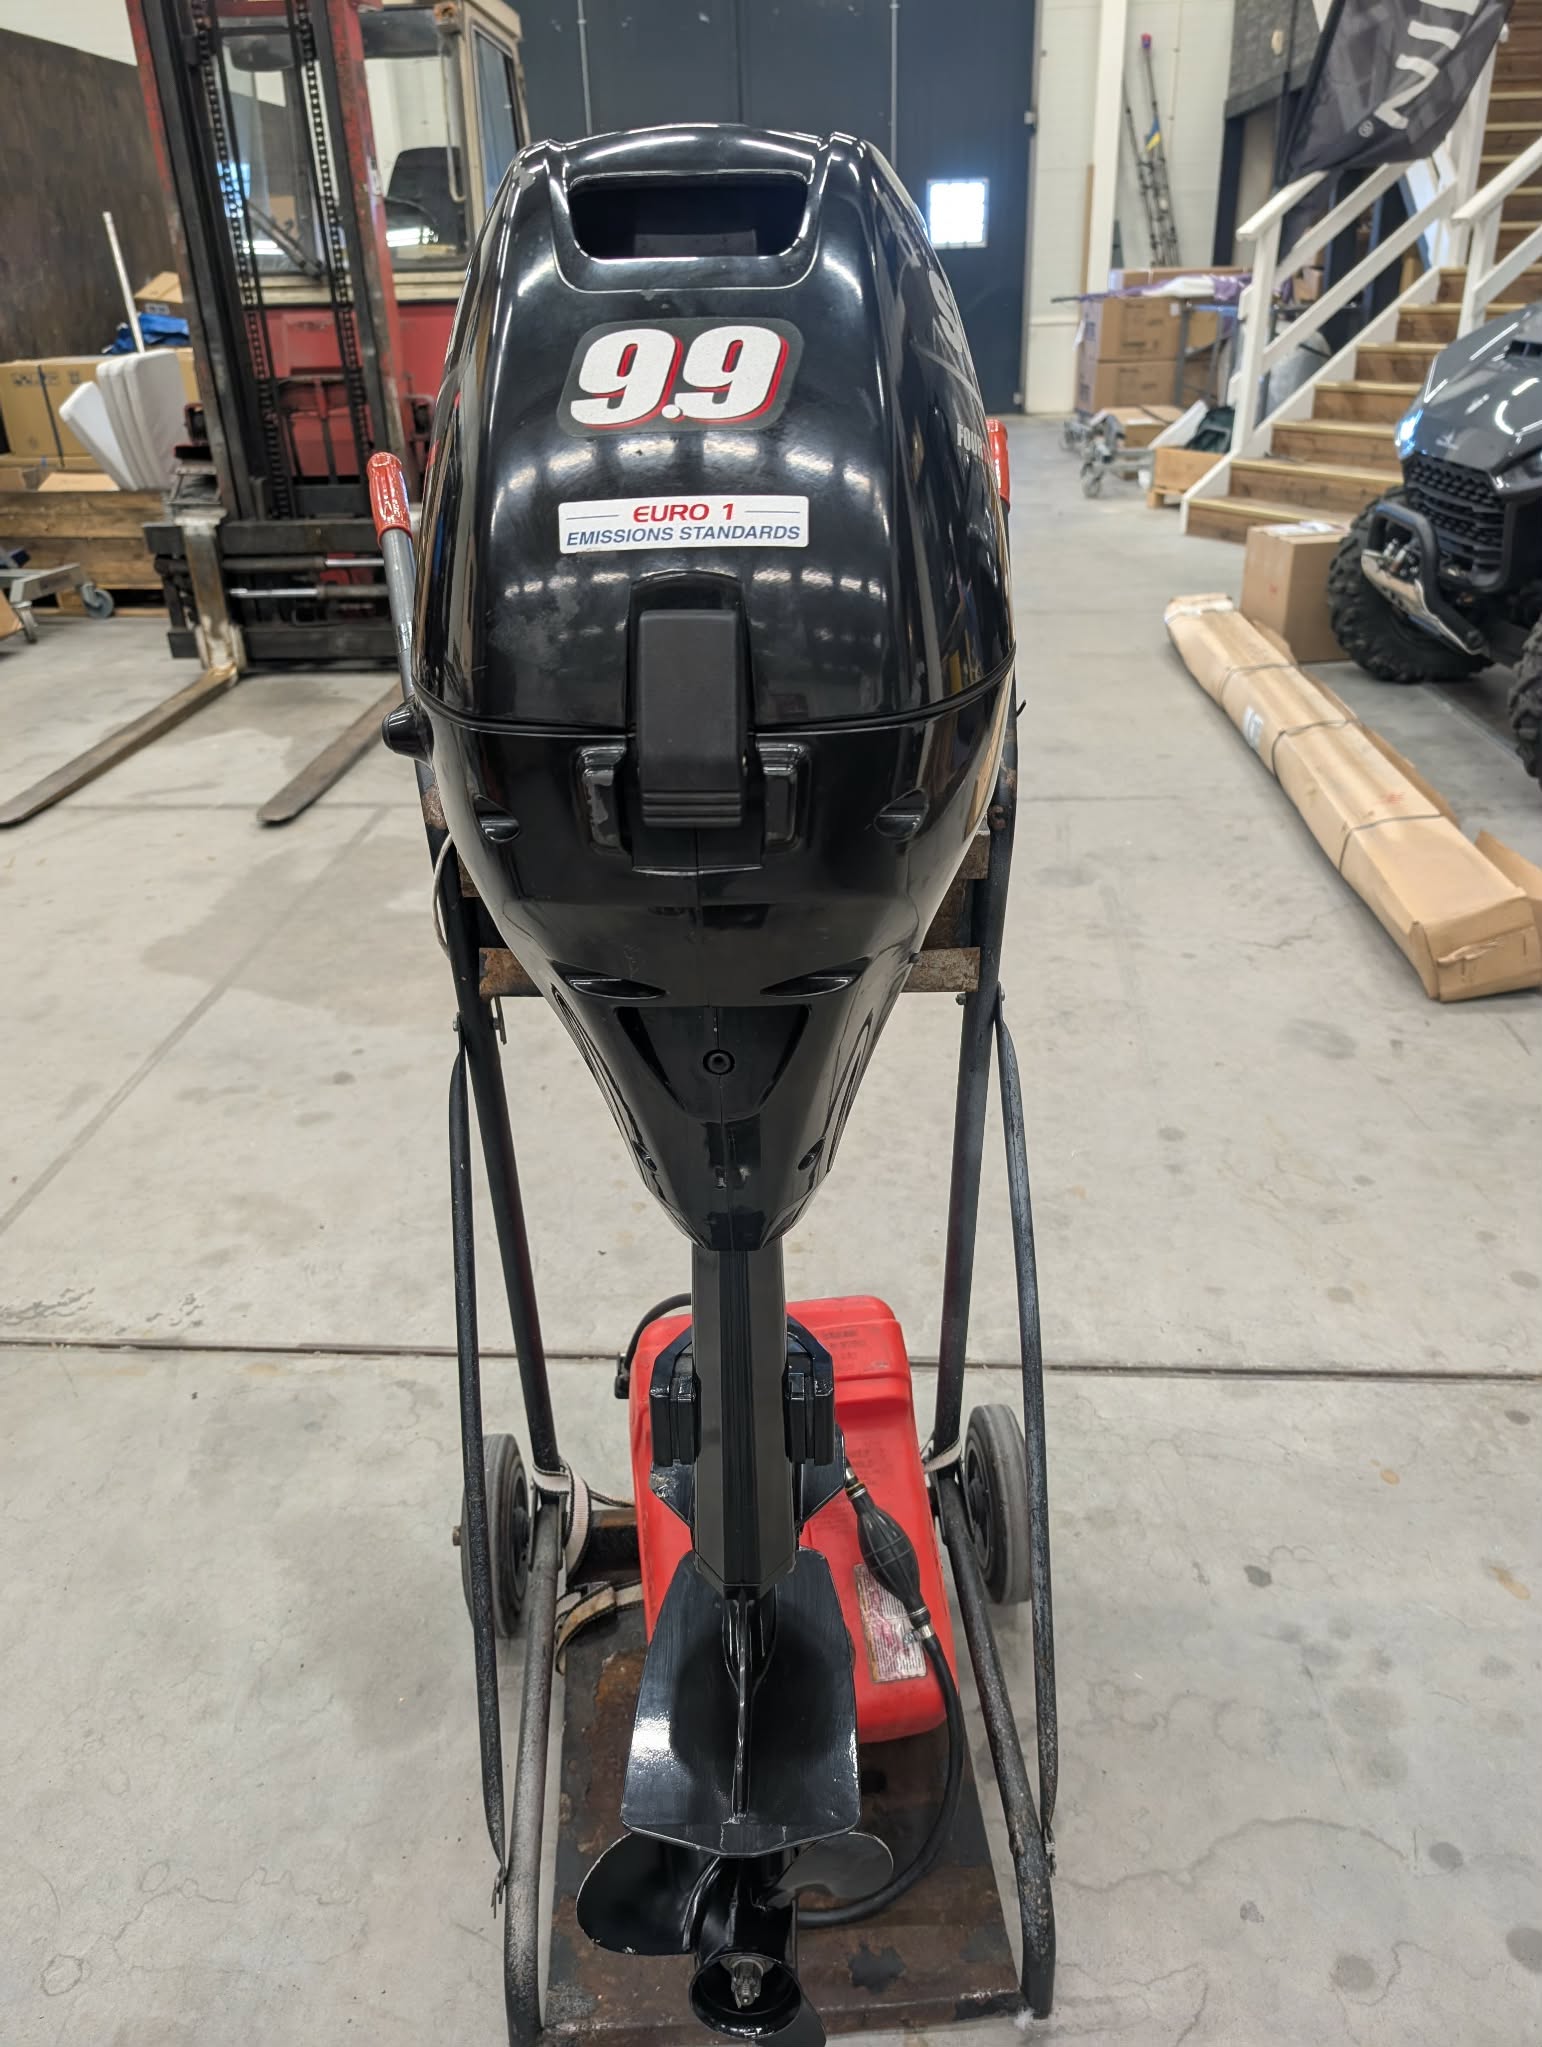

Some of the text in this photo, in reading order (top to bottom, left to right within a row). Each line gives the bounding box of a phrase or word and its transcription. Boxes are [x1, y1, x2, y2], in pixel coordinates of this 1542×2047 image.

[570, 325, 789, 429] 9.9
[633, 503, 737, 523] EURO 1
[567, 525, 801, 546] EMISSIONS STANDARDS
